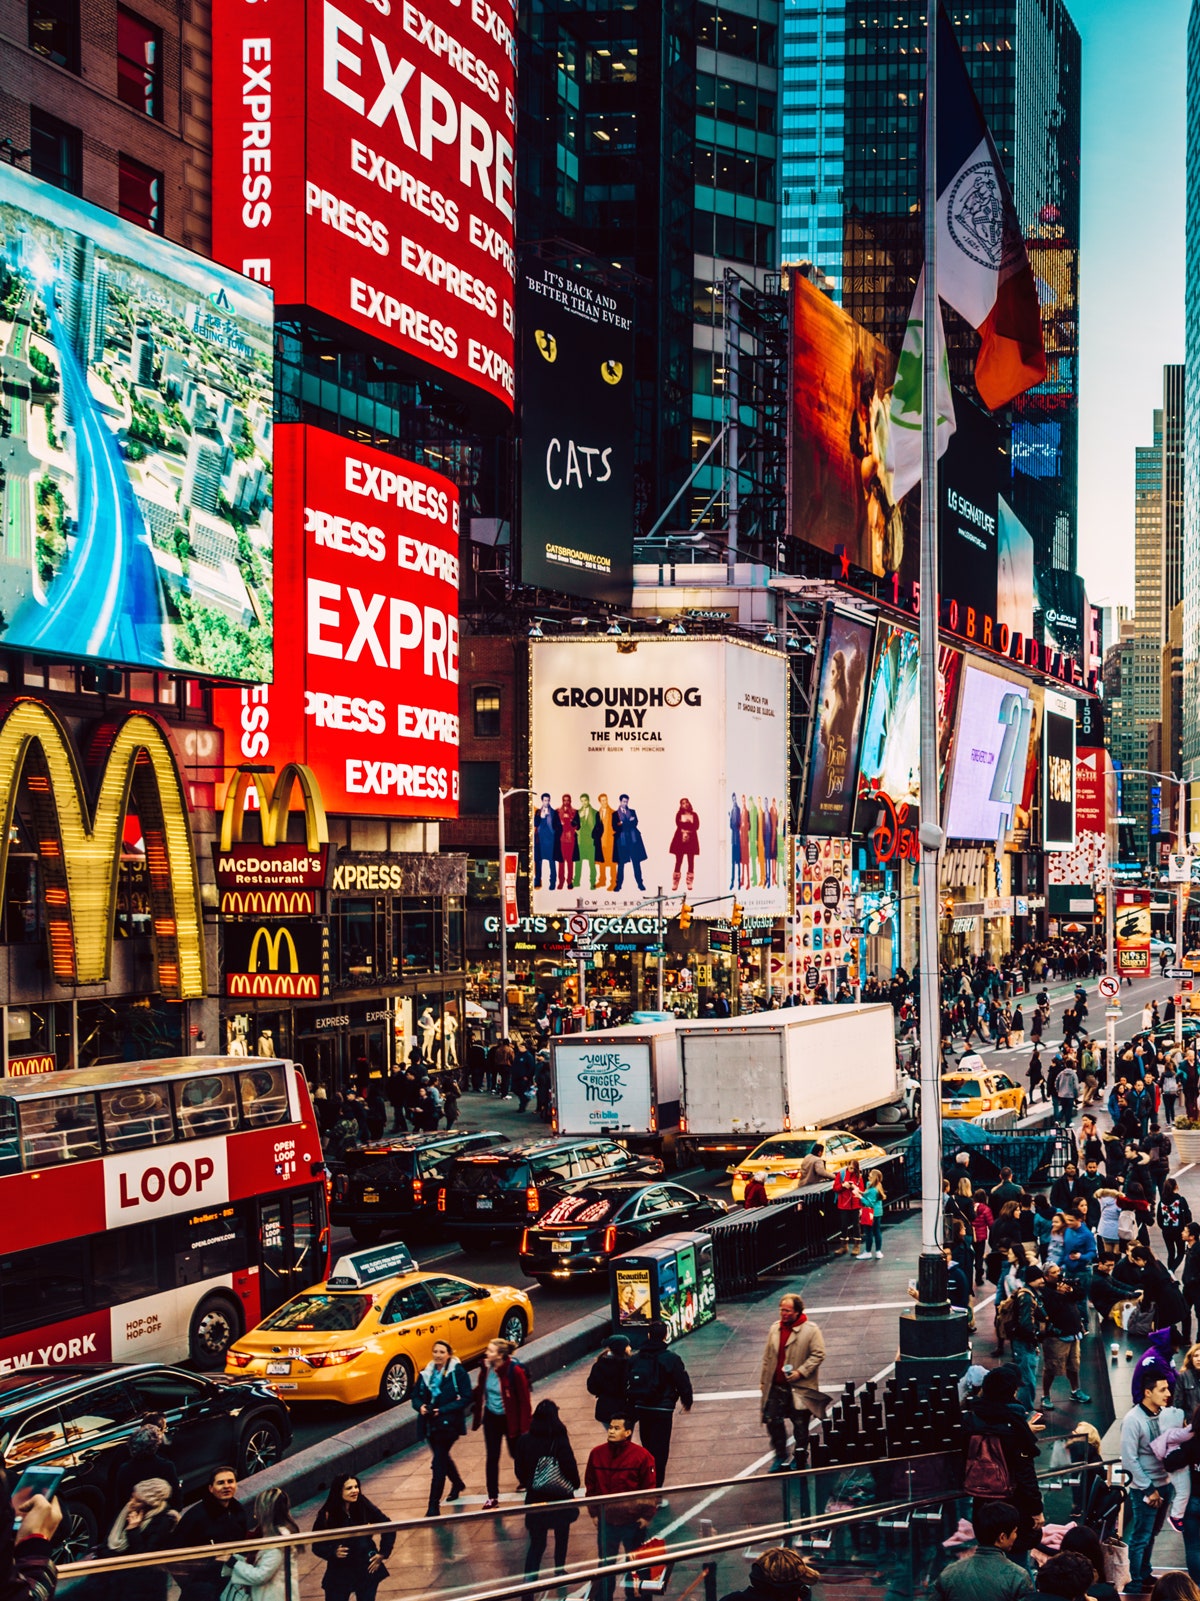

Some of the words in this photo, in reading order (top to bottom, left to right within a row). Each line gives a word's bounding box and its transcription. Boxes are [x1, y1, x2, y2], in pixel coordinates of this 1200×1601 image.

[403, 4, 500, 103] EXPRESS
[242, 37, 272, 229] EXPRESS
[350, 138, 459, 233] EXPRESS
[305, 180, 390, 257] PRESS
[401, 235, 498, 319] EXPRESS
[544, 270, 564, 288] IT'S
[566, 280, 593, 301] BACK
[595, 294, 617, 310] AND
[350, 276, 459, 360] EXPRESS
[570, 296, 600, 318] THAN
[546, 438, 612, 490] CATS
[344, 456, 449, 525] EXPRESS
[948, 488, 957, 511] LG
[958, 496, 995, 536] SIGNATURE
[545, 543, 611, 566] CATSBROADWAY.COM
[691, 610, 727, 619] LAMAR
[1057, 614, 1077, 624] LEXUS
[307, 577, 459, 686] EXPRE
[967, 606, 1077, 683] BROADWAY
[552, 686, 702, 709] GROUNDHOG
[604, 708, 647, 728] DAY
[591, 731, 610, 742] THE
[615, 731, 663, 742] MUSICAL
[345, 758, 449, 801] EXPRESS
[218, 857, 321, 873] McDonald's
[235, 874, 304, 884] Restaurant
[514, 942, 536, 950] Nikon
[315, 1015, 350, 1029] EXPRESS
[274, 1140, 295, 1152] OPEN
[274, 1150, 295, 1163] LOOP
[118, 1156, 215, 1208] LOOP
[126, 1314, 159, 1330] HOP-ON
[126, 1322, 162, 1341] HOP-OFF
[38, 1333, 97, 1366] YORK
